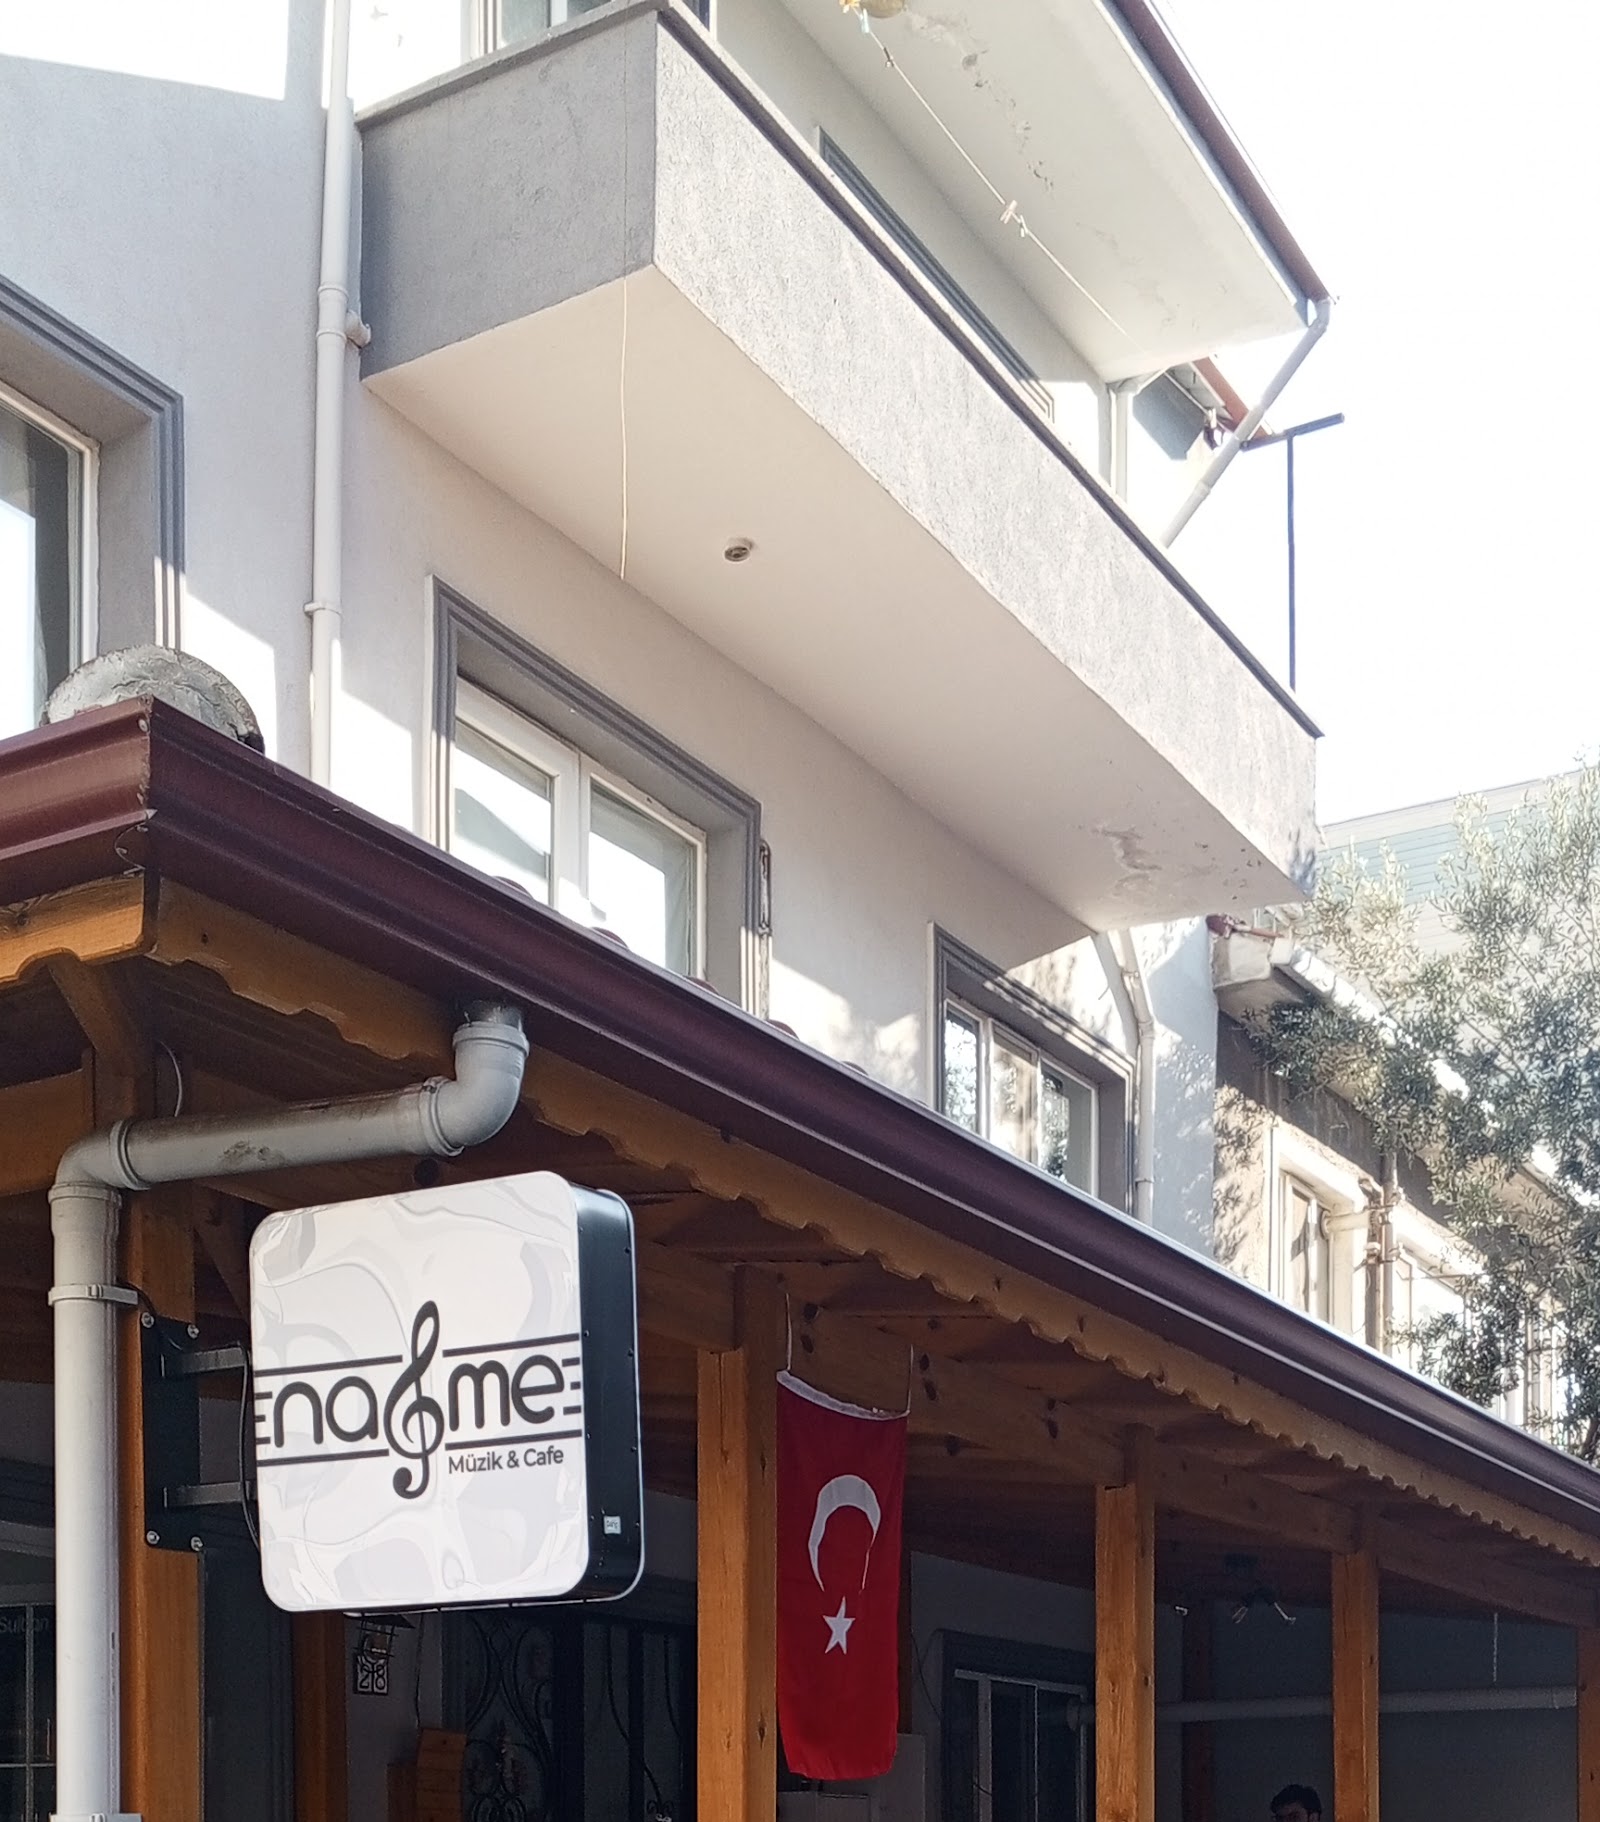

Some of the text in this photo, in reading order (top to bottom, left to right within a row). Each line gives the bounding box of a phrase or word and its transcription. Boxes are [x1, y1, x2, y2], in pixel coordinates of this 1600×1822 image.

[448, 1445, 564, 1474] Müzik & Cafe
